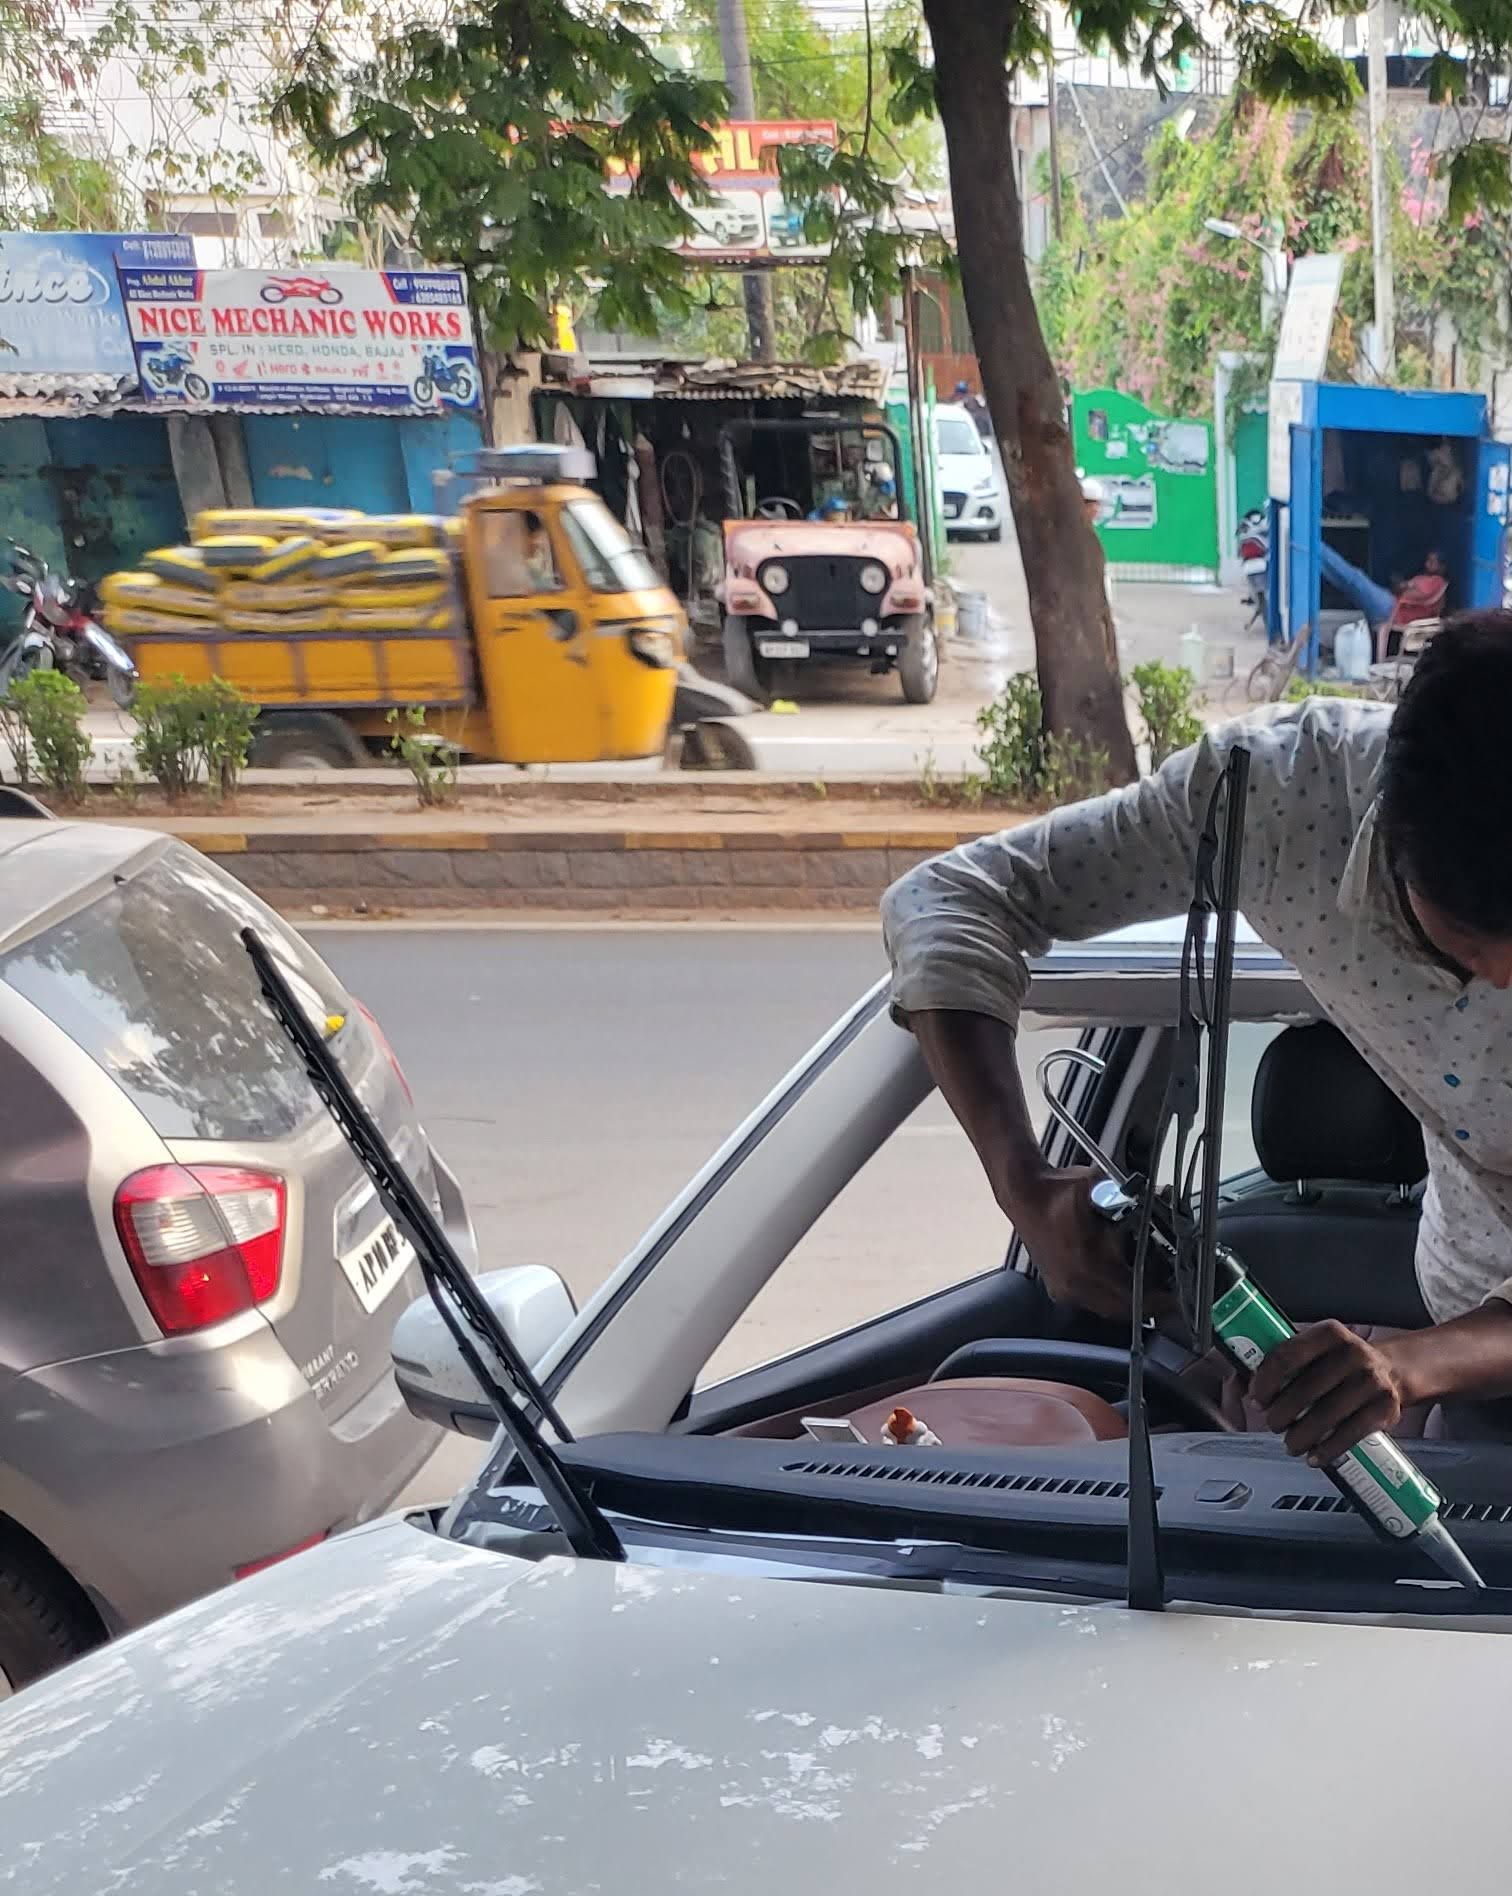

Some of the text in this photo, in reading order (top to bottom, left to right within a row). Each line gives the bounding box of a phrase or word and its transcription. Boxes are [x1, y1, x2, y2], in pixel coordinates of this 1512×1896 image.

[138, 307, 463, 341] NICE MECHANIC WORKS
[365, 347, 405, 358] BAJAJ
